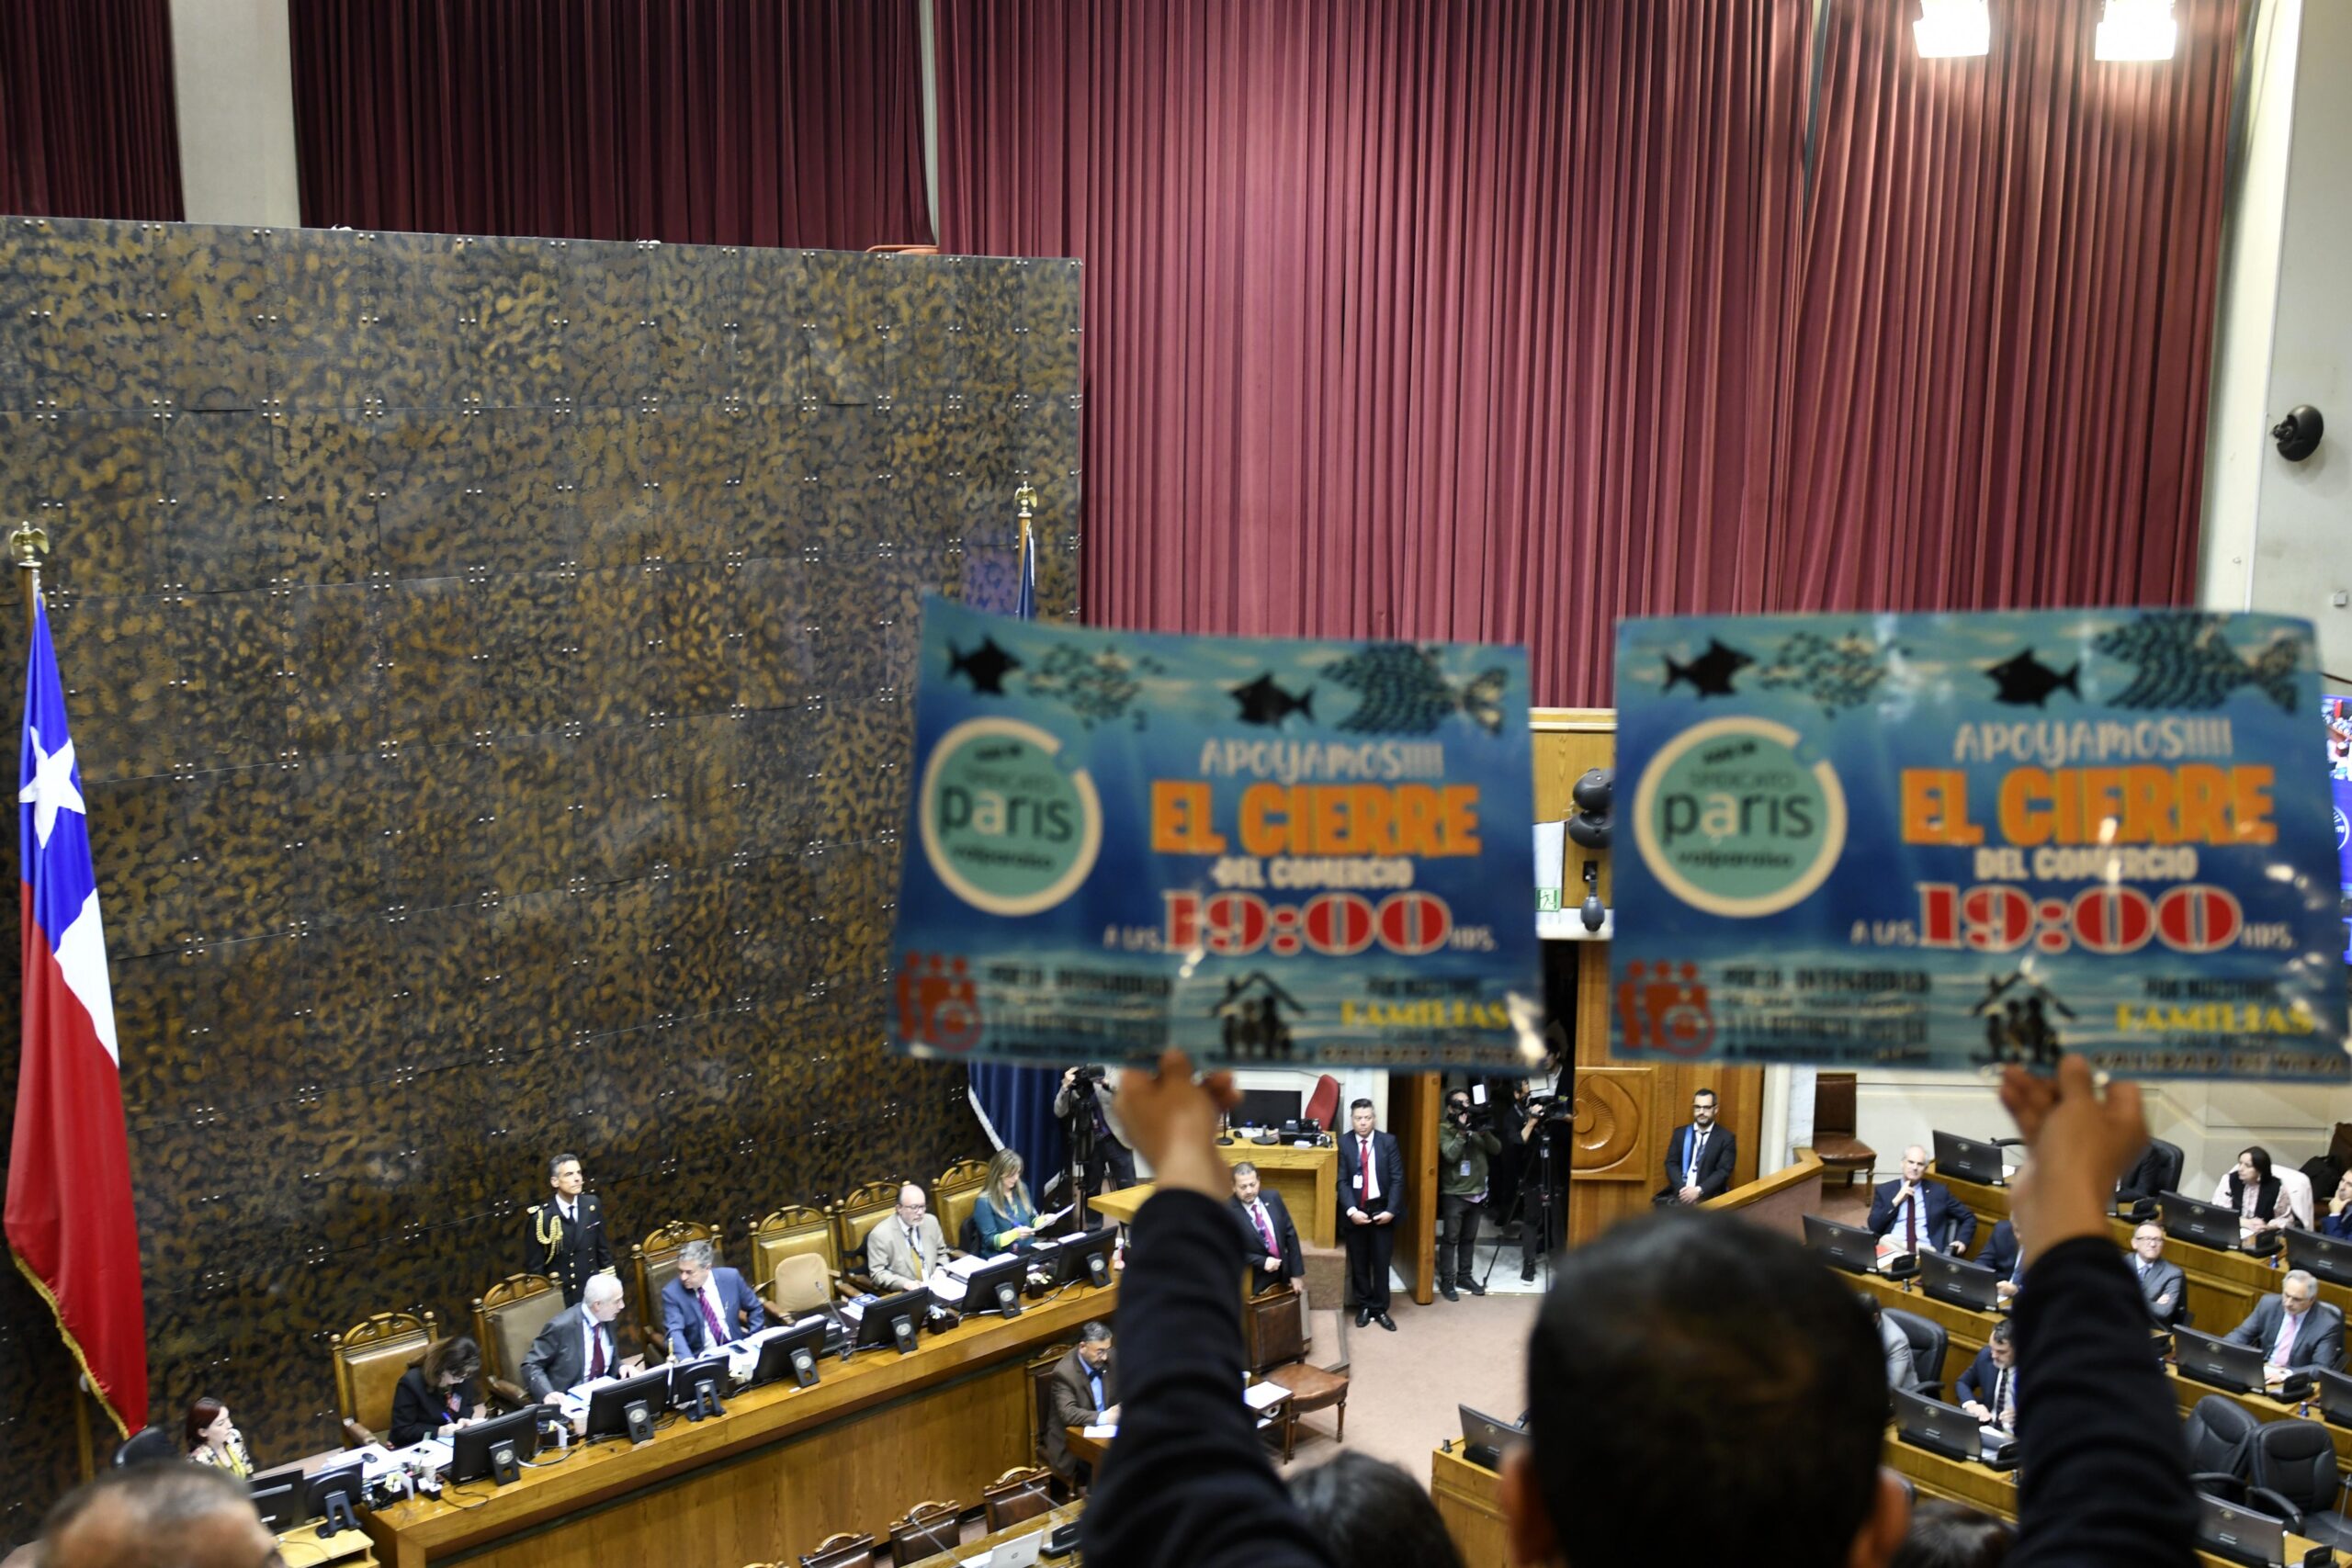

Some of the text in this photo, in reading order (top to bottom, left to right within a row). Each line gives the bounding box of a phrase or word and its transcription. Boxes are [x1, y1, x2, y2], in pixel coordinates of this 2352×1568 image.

[939, 785, 1073, 843] paris
[1151, 779, 1482, 859] EL CIERRE
[1663, 793, 1815, 847] paris
[1901, 763, 2278, 847] EL CIERRE
[1975, 845, 2030, 881] DEL
[1162, 888, 1453, 957] 19:00
[1916, 882, 2244, 955] 19:00
[2116, 1000, 2316, 1034] FAMILIAS
